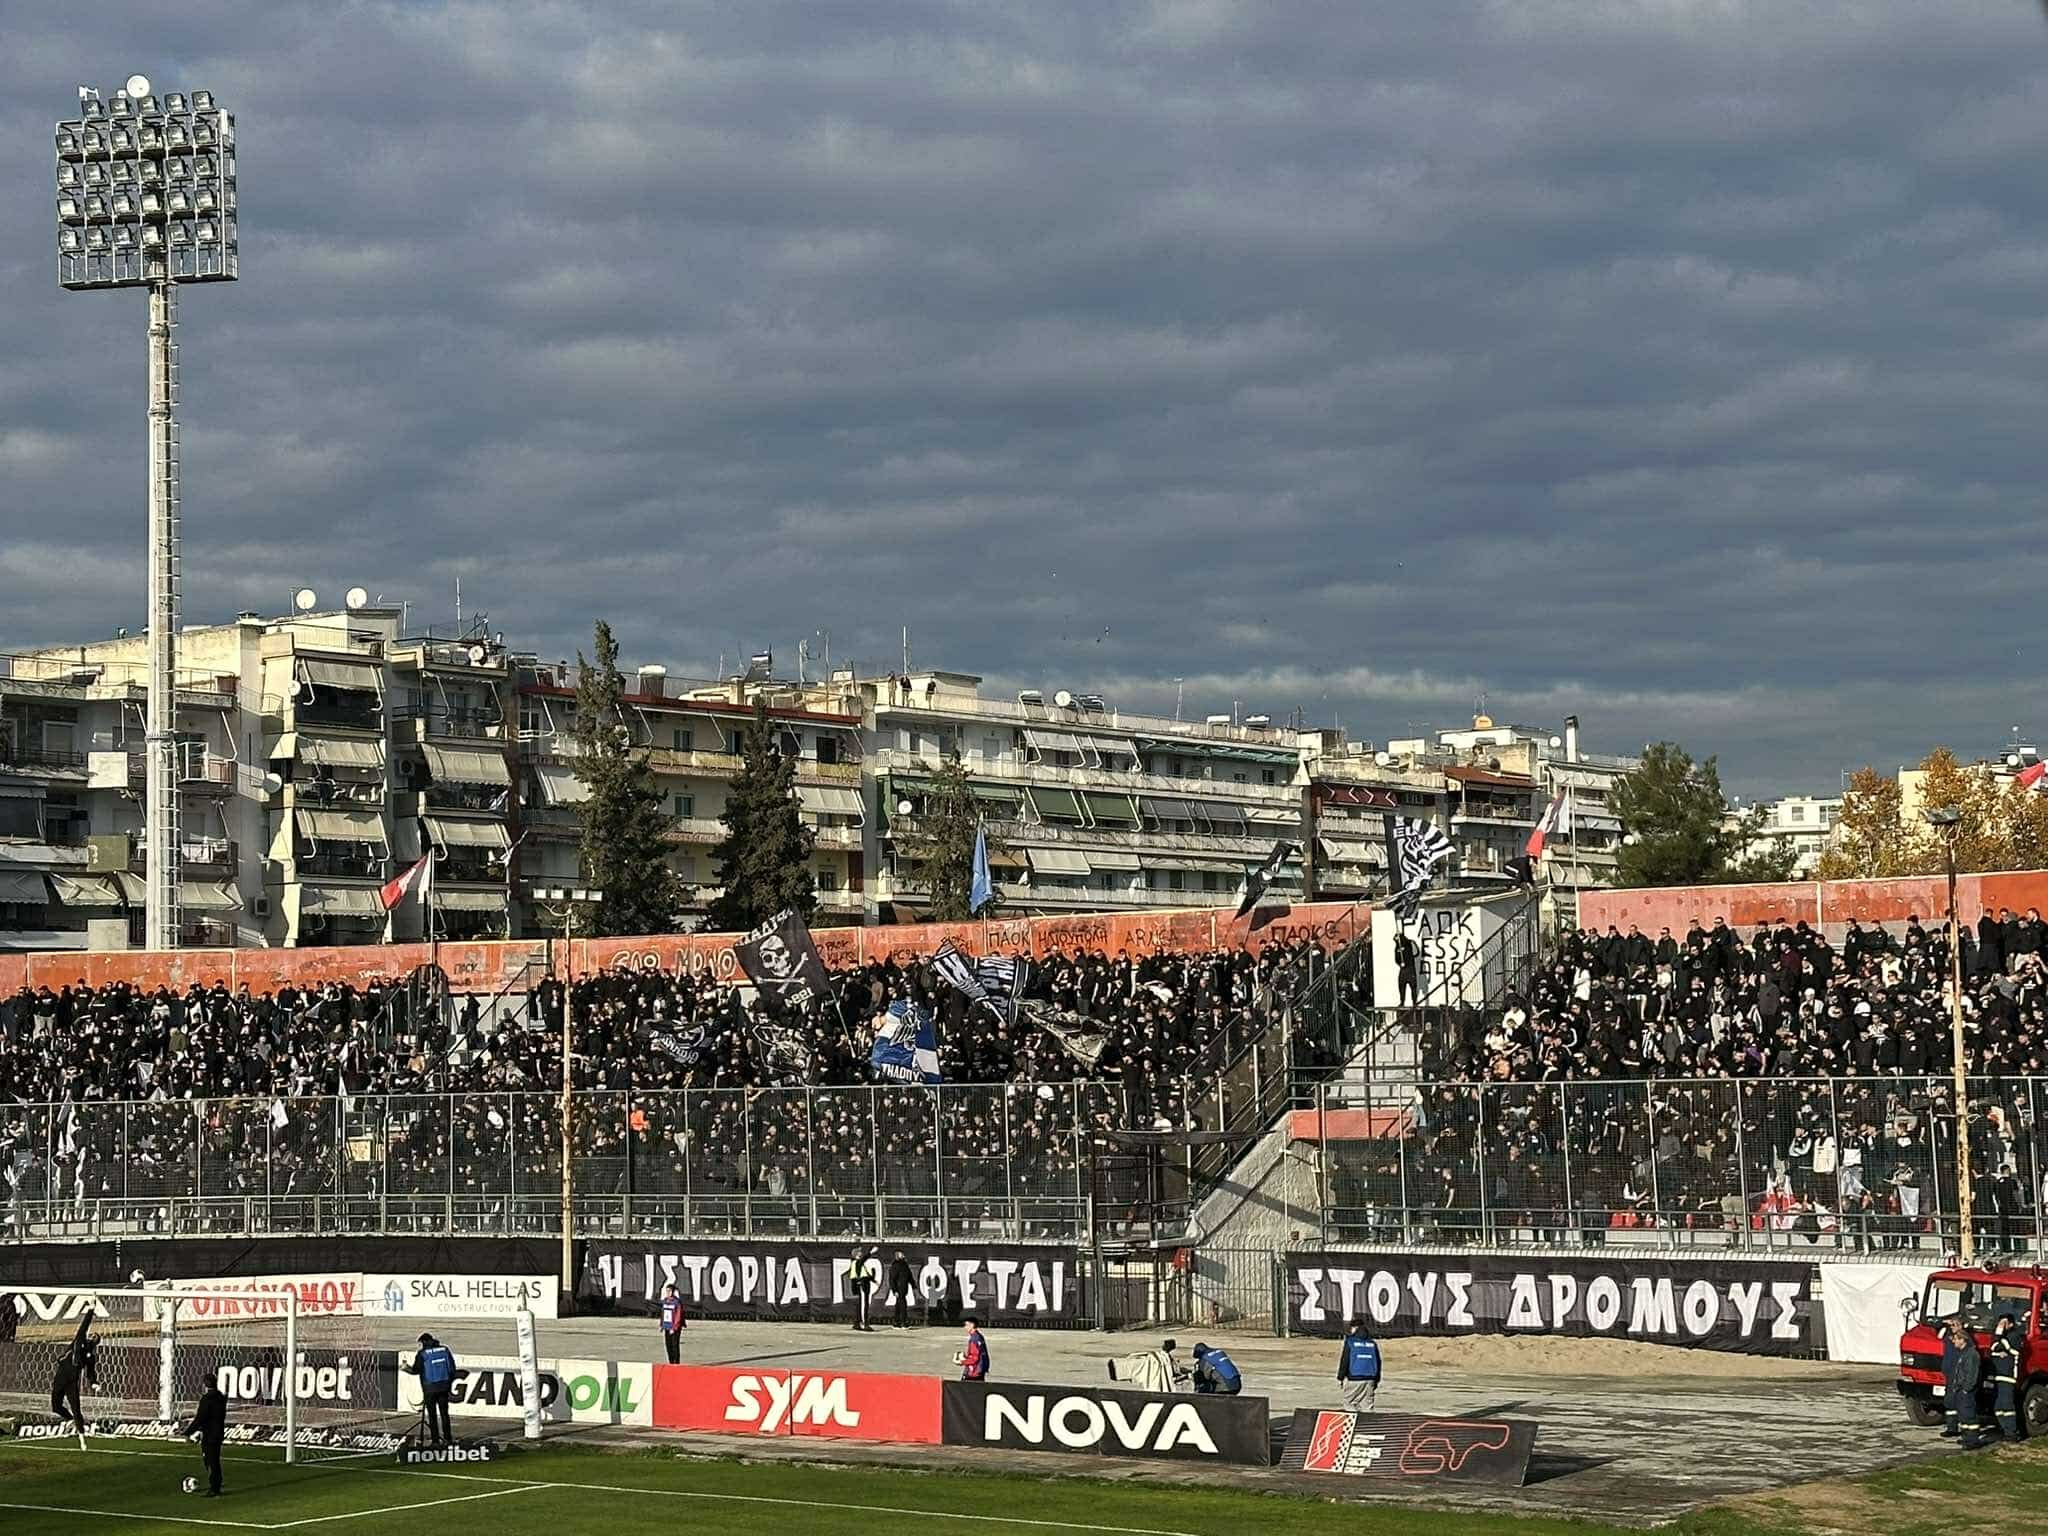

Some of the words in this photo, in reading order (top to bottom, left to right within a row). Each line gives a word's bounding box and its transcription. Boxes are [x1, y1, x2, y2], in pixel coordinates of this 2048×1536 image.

[989, 932, 1030, 948] ΠΑΟΚ
[411, 1279, 460, 1297] SKAL
[467, 1280, 542, 1298] HELLAS
[599, 1255, 622, 1299] Η
[645, 1254, 809, 1304] ΙΣΤΟΡΙΑ
[438, 1302, 512, 1312] CONSTRUCTION
[1298, 1268, 1474, 1326] ΣΤΟΥΣ
[1507, 1274, 1799, 1338] ΔΡΟΜΟΥΣ
[724, 1375, 860, 1432] SYM
[113, 1421, 180, 1436] novibet
[984, 1394, 1219, 1453] NOVA
[407, 1445, 490, 1462] novibet
